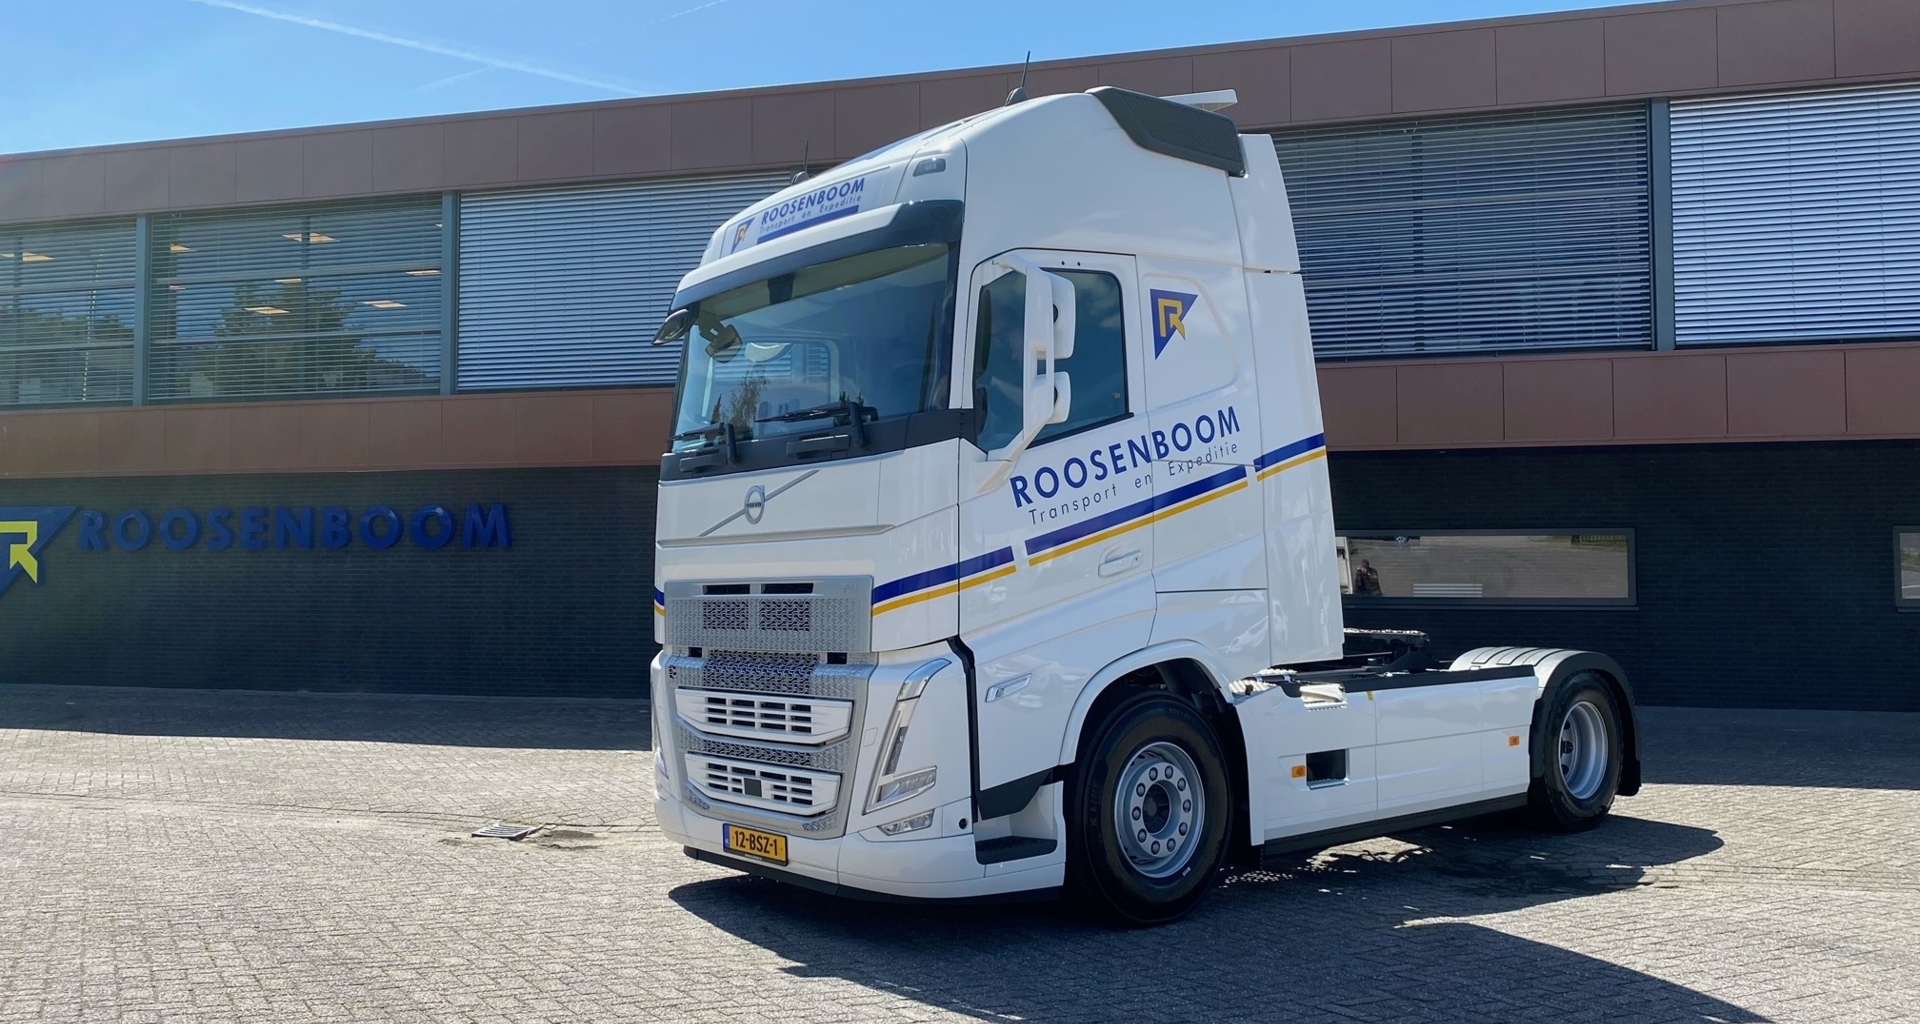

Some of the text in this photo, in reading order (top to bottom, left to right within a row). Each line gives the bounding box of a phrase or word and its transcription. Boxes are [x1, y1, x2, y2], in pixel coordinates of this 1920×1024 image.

[759, 194, 862, 234] Transport en Expeditie
[761, 178, 865, 225] ROOSENBOOM
[1009, 406, 1240, 508] ROOSENBOOM
[1028, 441, 1238, 525] Transport en Expeditie
[79, 504, 511, 552] ROOSENBOOM
[734, 830, 778, 856] 12-BSZ-1
